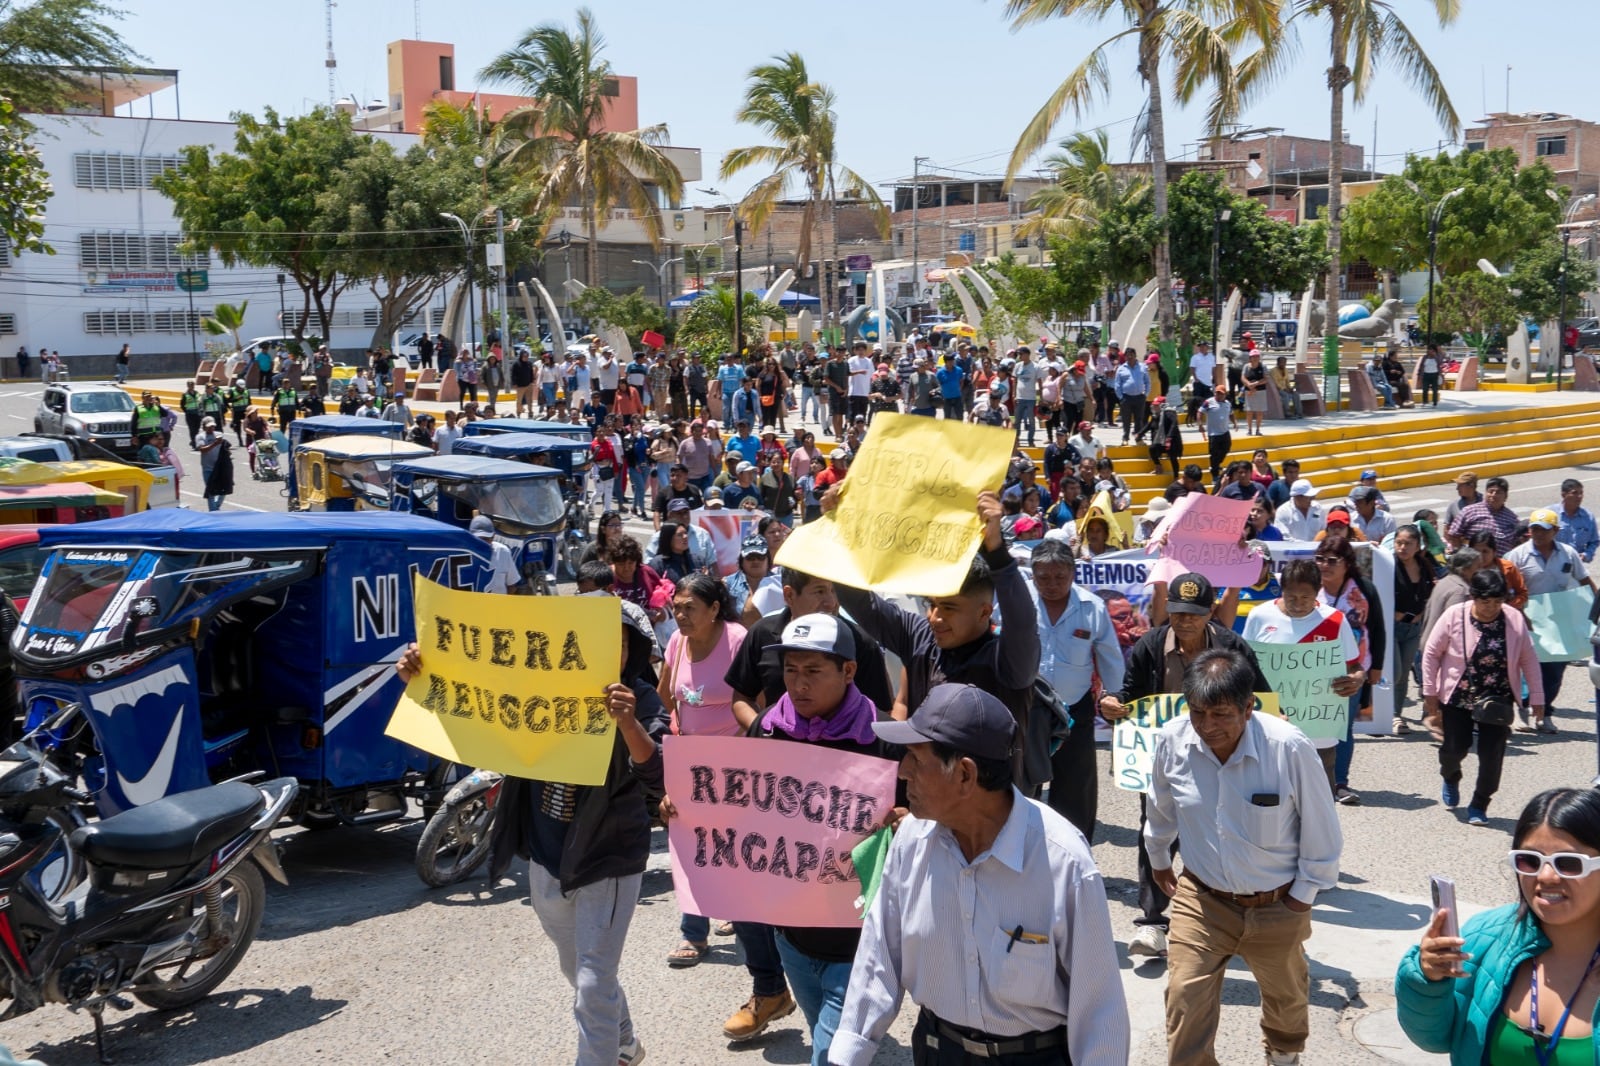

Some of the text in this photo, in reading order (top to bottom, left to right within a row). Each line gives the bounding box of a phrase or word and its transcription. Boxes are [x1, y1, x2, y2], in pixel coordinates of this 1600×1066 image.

[1074, 563, 1148, 585] EREMOS
[434, 615, 587, 671] FUERA
[423, 673, 612, 736] REUSCHE
[1117, 730, 1148, 752] LA
[690, 765, 879, 835] REUSCHE
